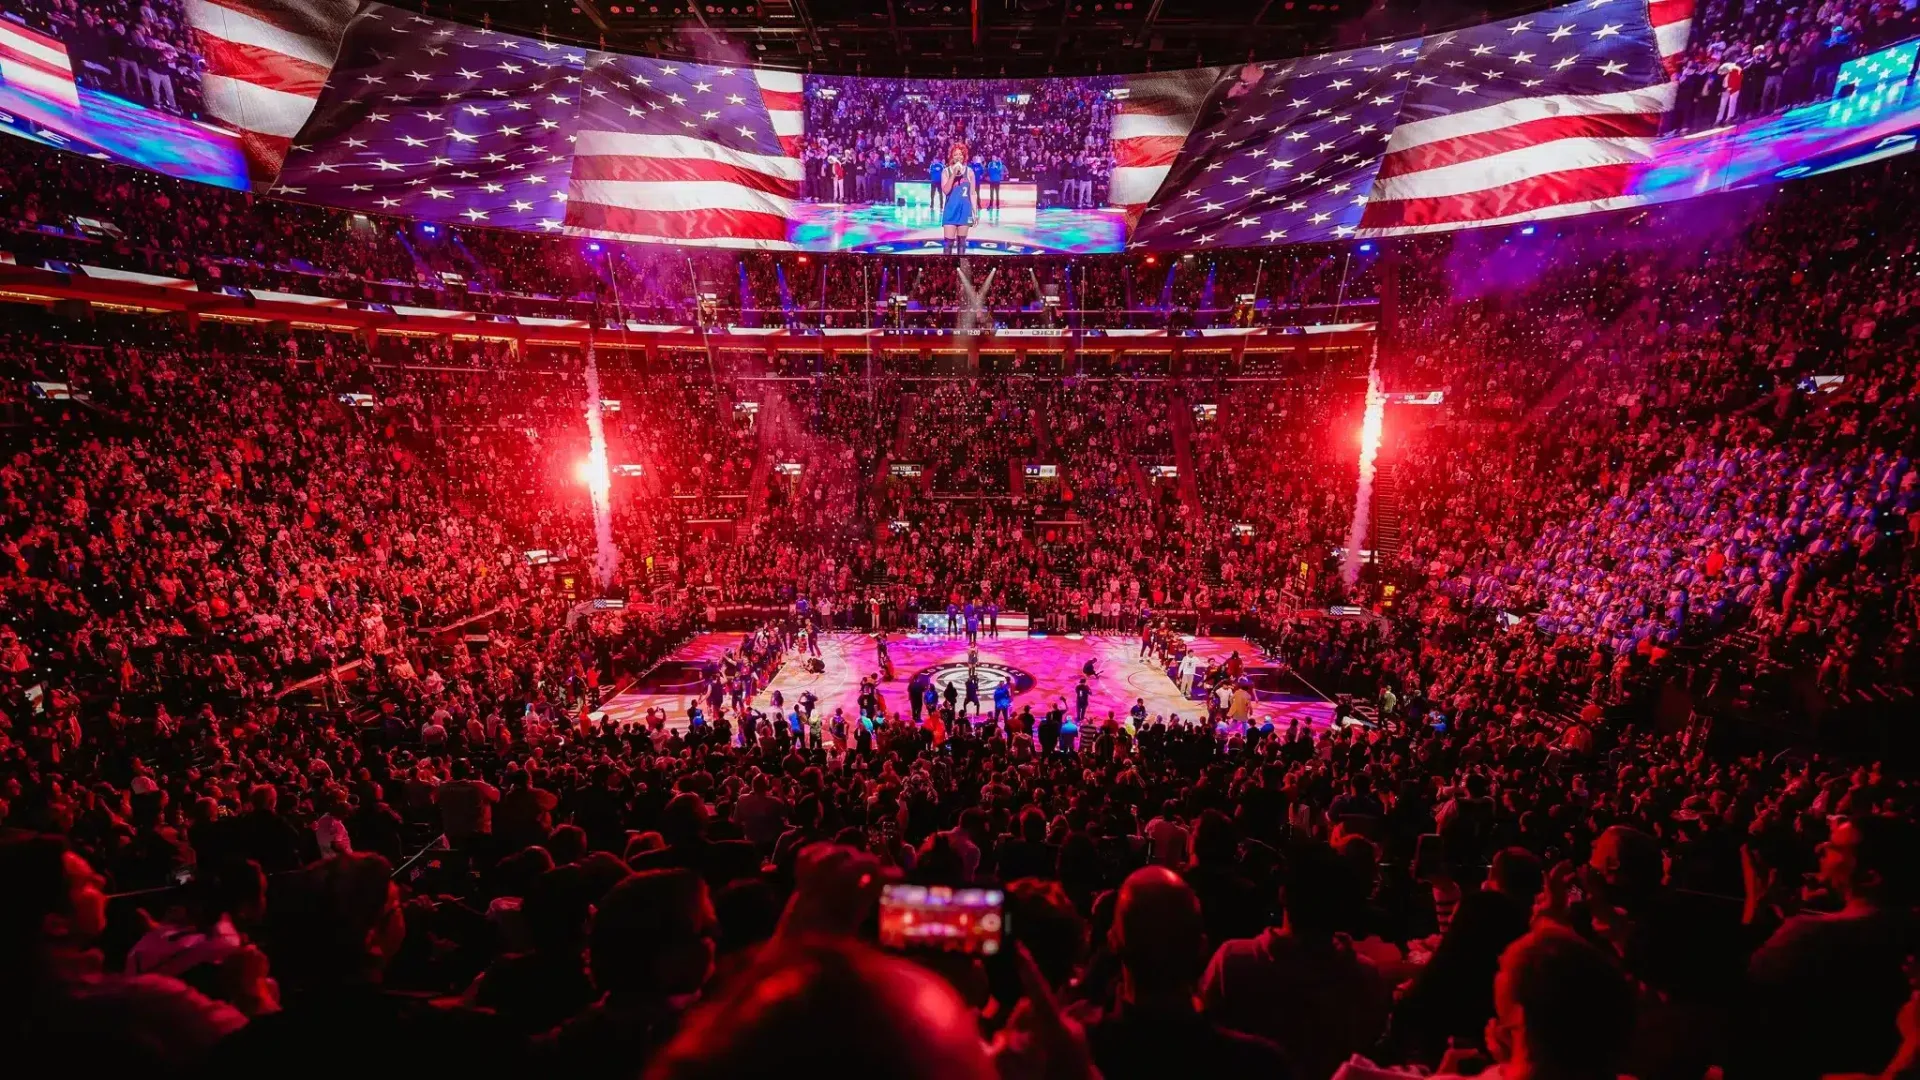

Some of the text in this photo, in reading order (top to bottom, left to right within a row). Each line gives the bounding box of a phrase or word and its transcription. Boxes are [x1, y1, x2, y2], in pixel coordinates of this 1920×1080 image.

[961, 186, 968, 197] 2
[920, 663, 1026, 677] LOS AGELES
